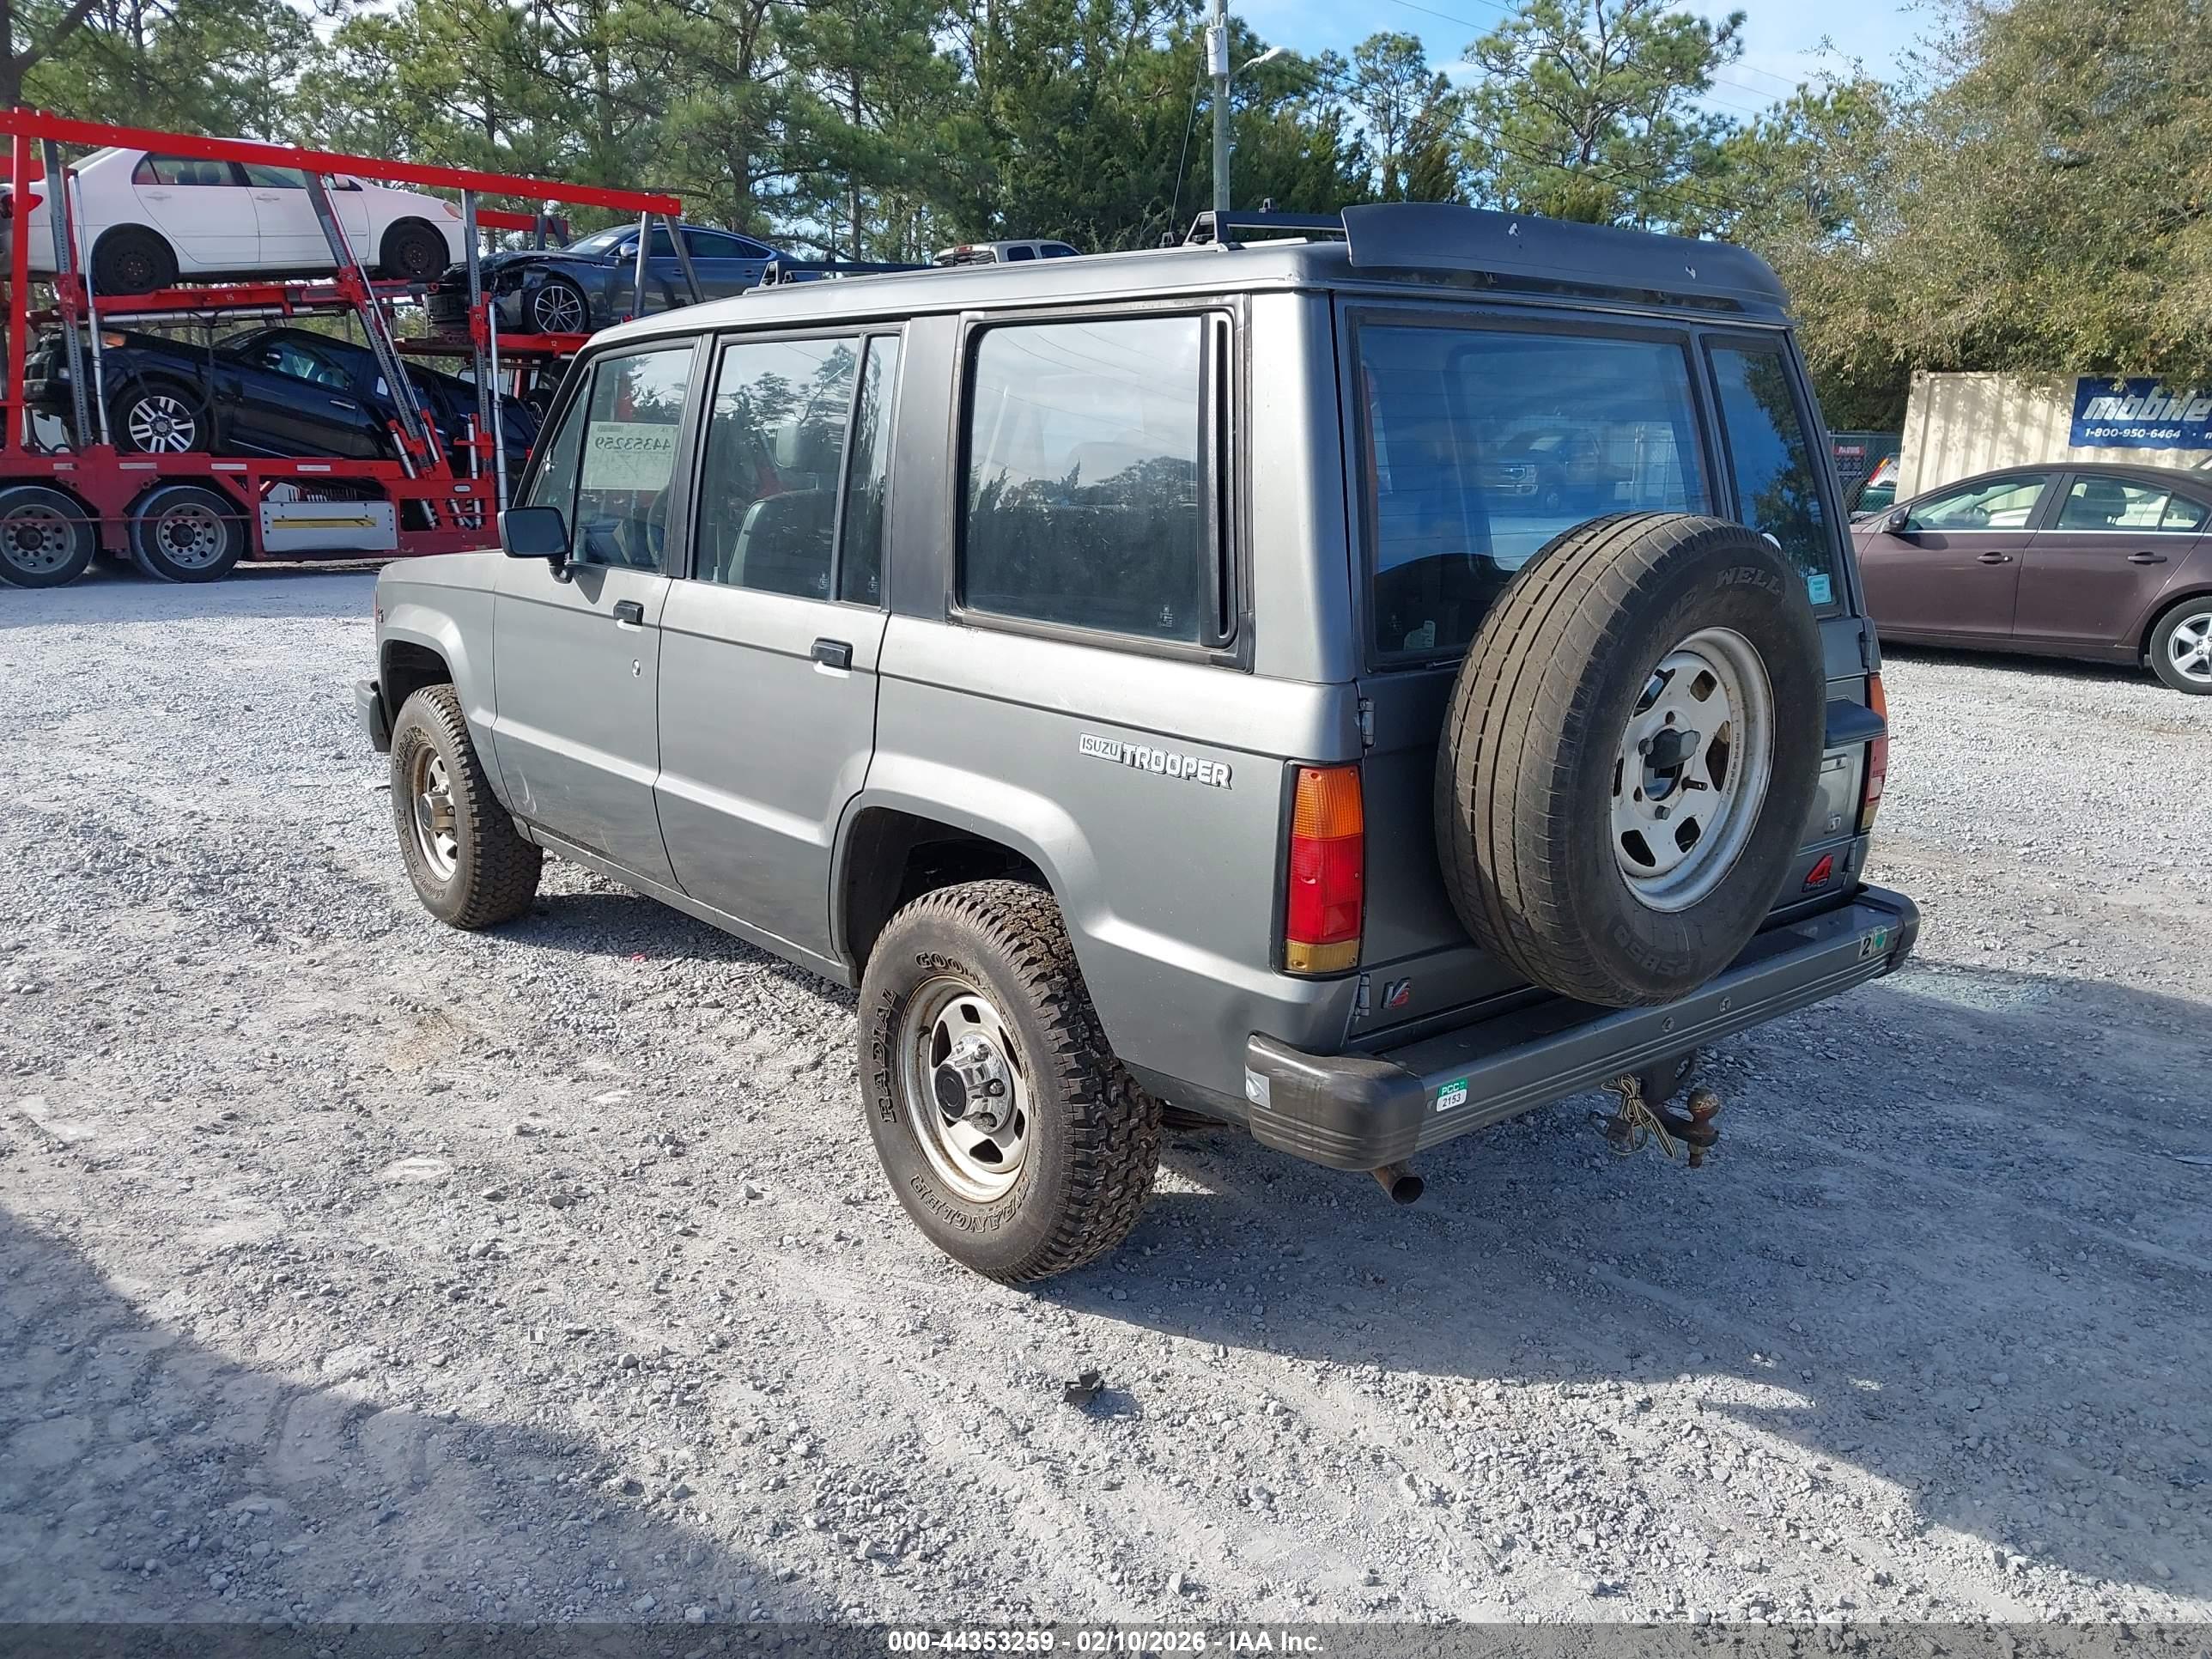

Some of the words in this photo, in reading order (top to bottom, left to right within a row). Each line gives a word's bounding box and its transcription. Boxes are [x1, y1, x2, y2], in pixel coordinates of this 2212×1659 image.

[2085, 428, 2181, 439] 1-800-950-6464
[1080, 736, 1121, 759] ISUZU
[1122, 742, 1232, 790] TROOPER
[1862, 937, 1872, 956] 2
[872, 988, 897, 1123] RADIAL
[1441, 1082, 1460, 1096] PCC
[1443, 1093, 1462, 1108] 2153
